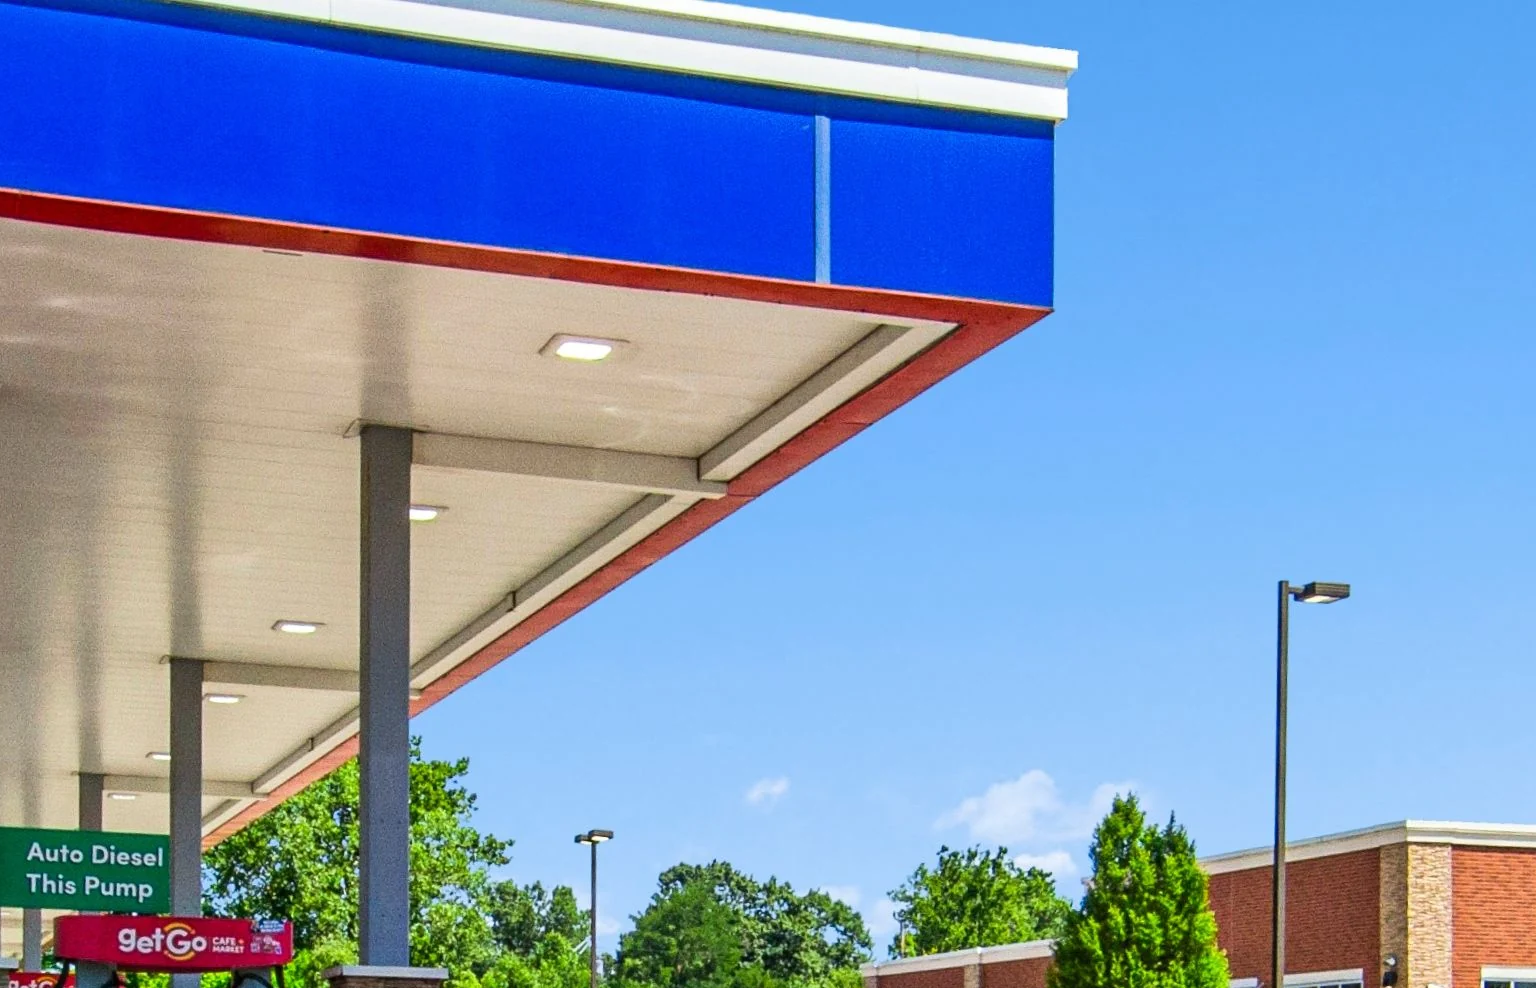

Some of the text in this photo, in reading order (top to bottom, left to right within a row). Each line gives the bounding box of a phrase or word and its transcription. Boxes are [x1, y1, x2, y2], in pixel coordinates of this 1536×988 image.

[27, 842, 163, 867] Auto Diesel
[26, 873, 153, 902] This Pump
[118, 927, 207, 954] getGo
[212, 936, 236, 945] CAFE
